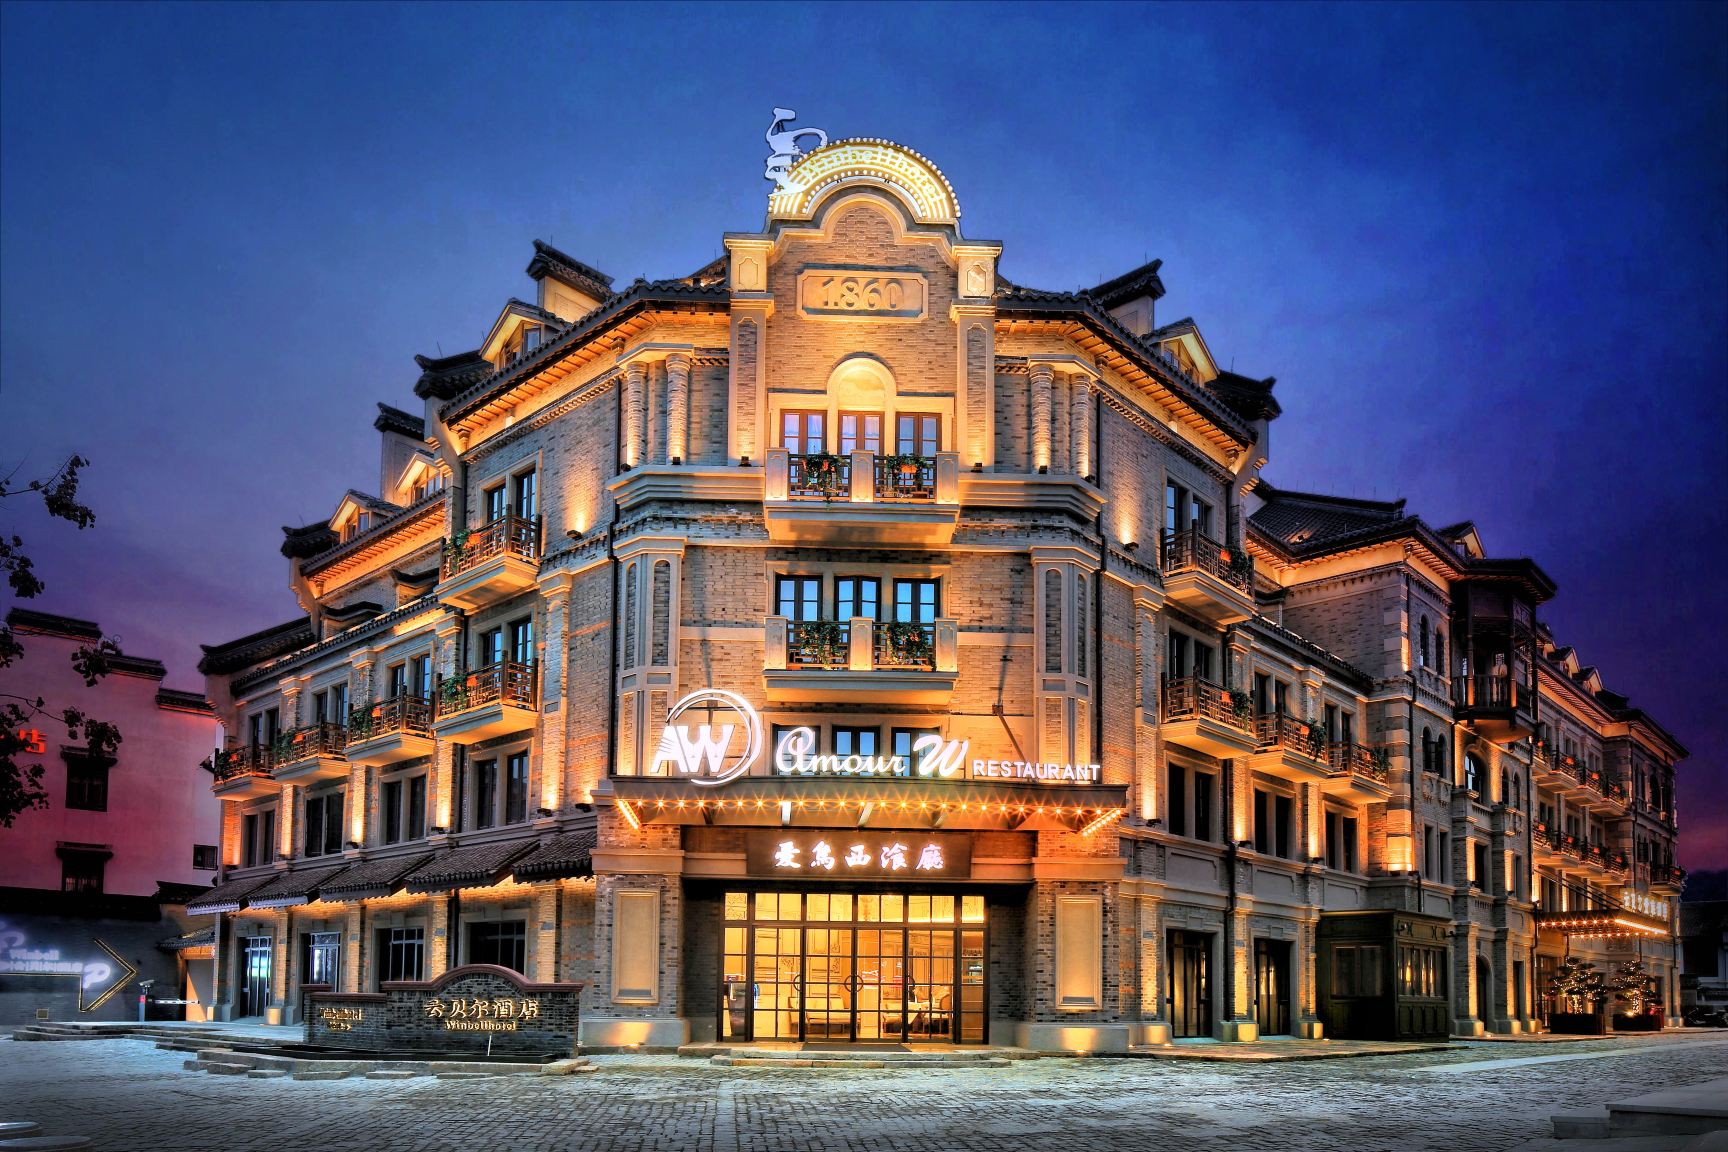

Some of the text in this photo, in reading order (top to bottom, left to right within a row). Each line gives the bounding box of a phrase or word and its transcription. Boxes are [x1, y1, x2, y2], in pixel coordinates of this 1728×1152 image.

[822, 277, 904, 311] 1860
[775, 726, 1101, 781] Amour W RESTAURANT
